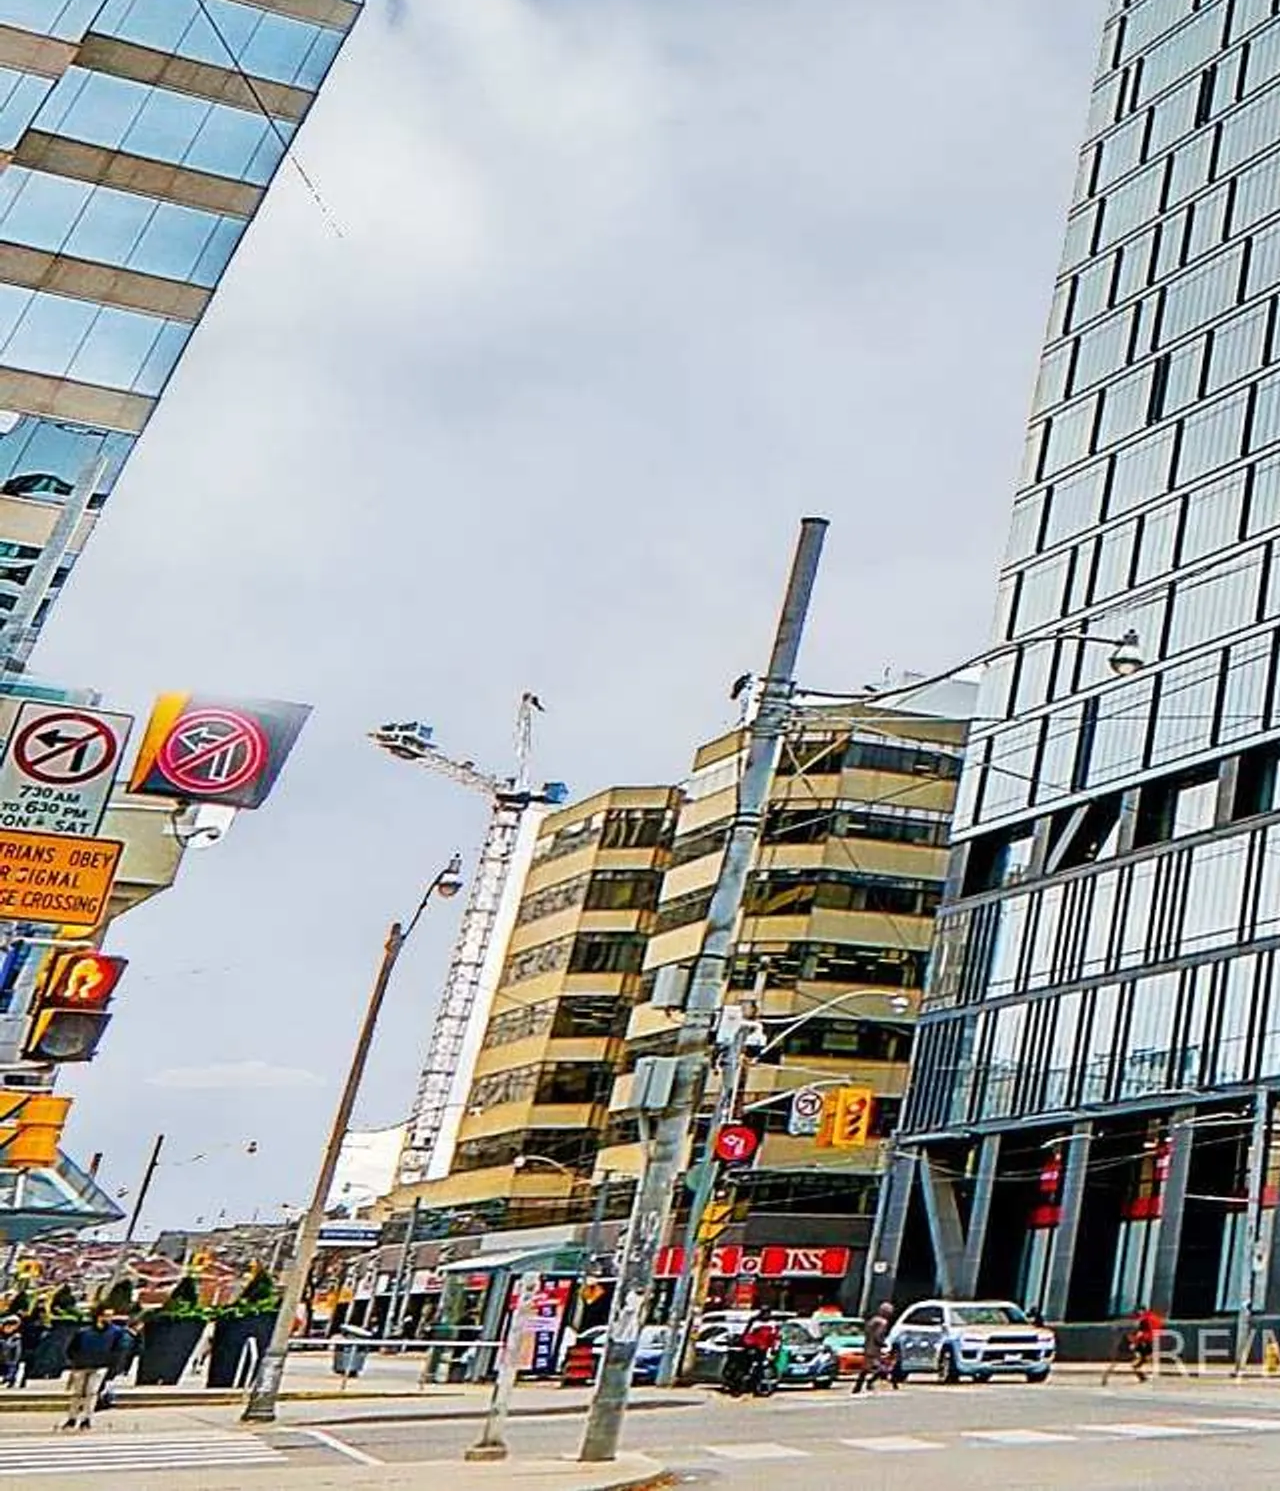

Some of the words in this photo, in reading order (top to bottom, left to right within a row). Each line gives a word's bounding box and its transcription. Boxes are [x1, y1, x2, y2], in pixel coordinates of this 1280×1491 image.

[19, 784, 53, 799] 730
[53, 792, 80, 803] AM
[2, 801, 20, 812] TO
[25, 800, 60, 814] 630
[62, 807, 87, 818] PM
[0, 813, 31, 827] ON
[53, 820, 91, 833] SAT
[68, 849, 113, 868] OBEY
[15, 866, 80, 888] SIGNAL
[20, 890, 99, 913] CROSSING
